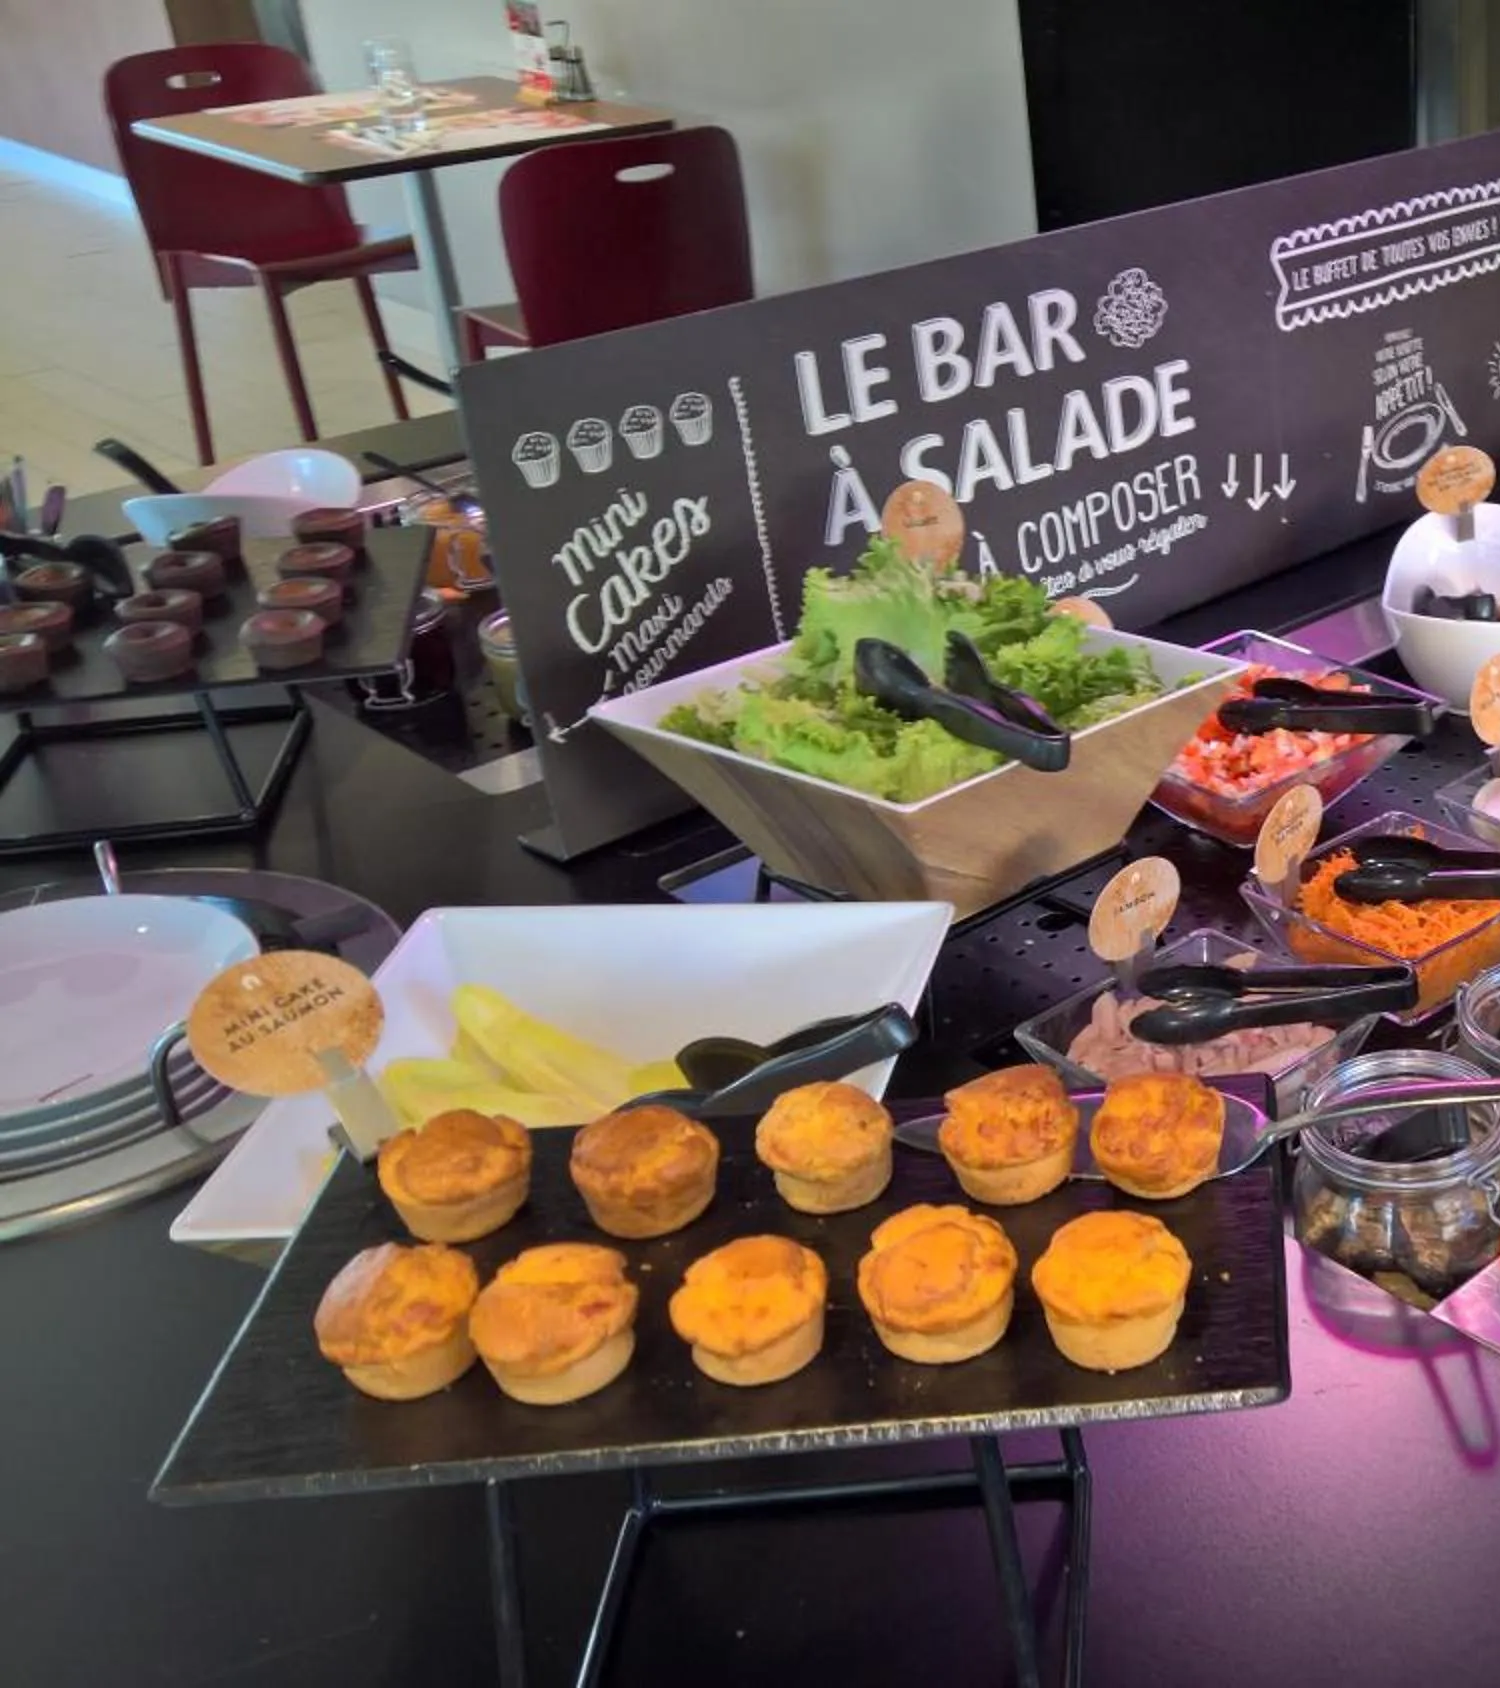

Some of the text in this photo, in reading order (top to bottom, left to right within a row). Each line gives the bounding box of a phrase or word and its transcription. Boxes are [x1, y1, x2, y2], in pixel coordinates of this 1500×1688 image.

[1291, 265, 1311, 292] LE
[1313, 255, 1360, 286] BUFFET
[1360, 249, 1379, 273] DE
[1381, 236, 1426, 268] TOUTES
[1427, 229, 1451, 255] VOS
[794, 287, 1087, 436] LE BAR
[823, 358, 1197, 547] À SALADE
[551, 487, 649, 586] mini
[971, 454, 1202, 584] À COMPOSER
[566, 496, 712, 654] Cakes
[608, 593, 683, 673] maxi
[223, 977, 327, 1039] MINI CAKE
[229, 985, 345, 1054] AU SAUMON
